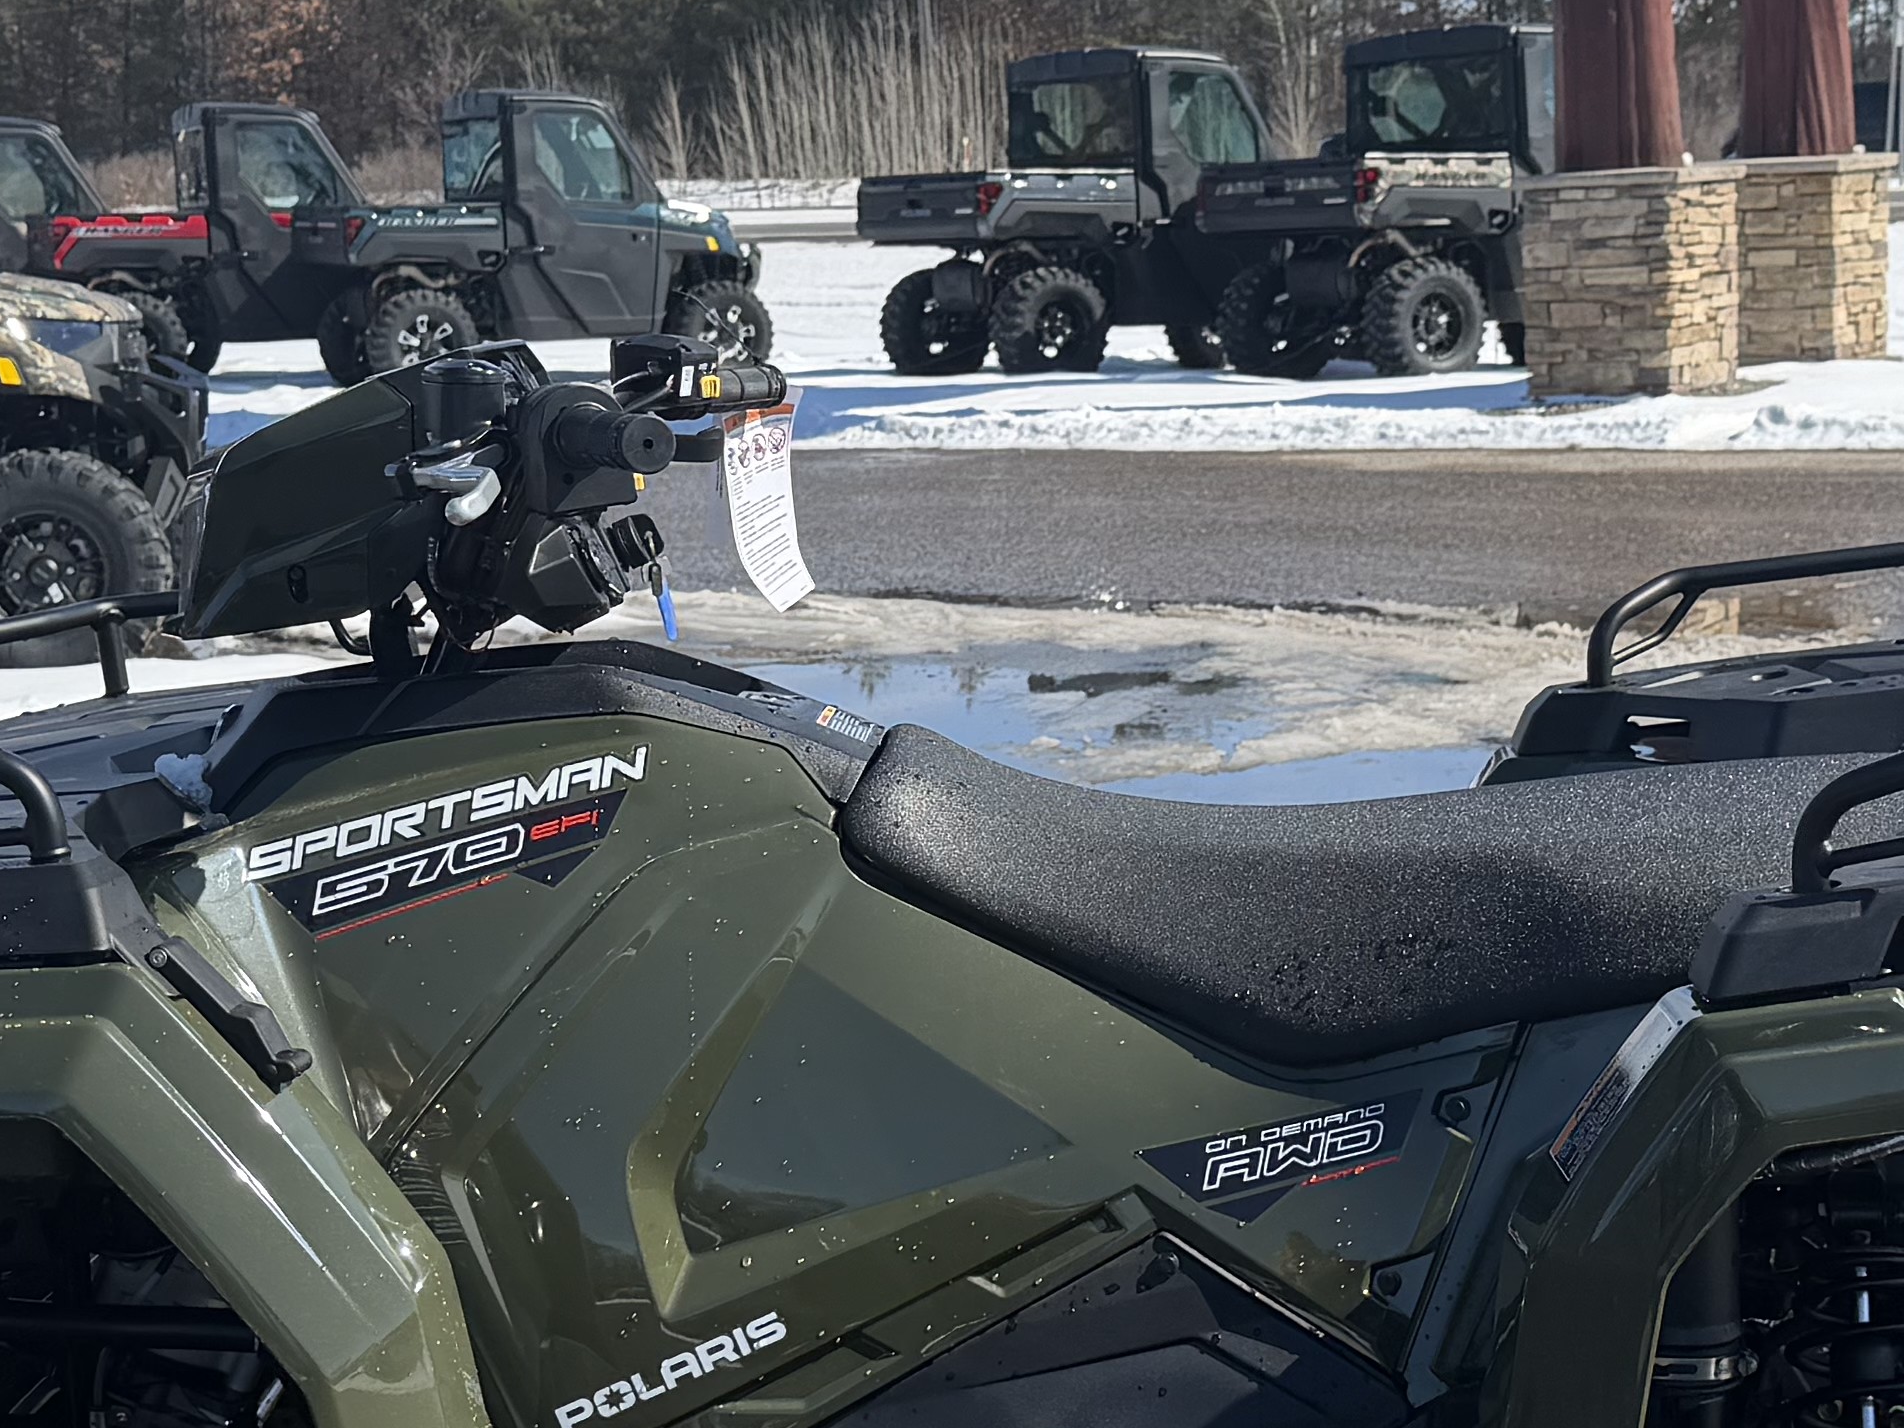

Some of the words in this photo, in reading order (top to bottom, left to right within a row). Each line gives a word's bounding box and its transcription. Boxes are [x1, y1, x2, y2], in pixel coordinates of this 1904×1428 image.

[243, 746, 647, 883] SPORTSMAN
[312, 821, 525, 916] 570
[530, 809, 599, 841] EFI
[1202, 1119, 1384, 1192] AWD
[1205, 1134, 1247, 1154] ON
[1260, 1103, 1385, 1142] DEMAND
